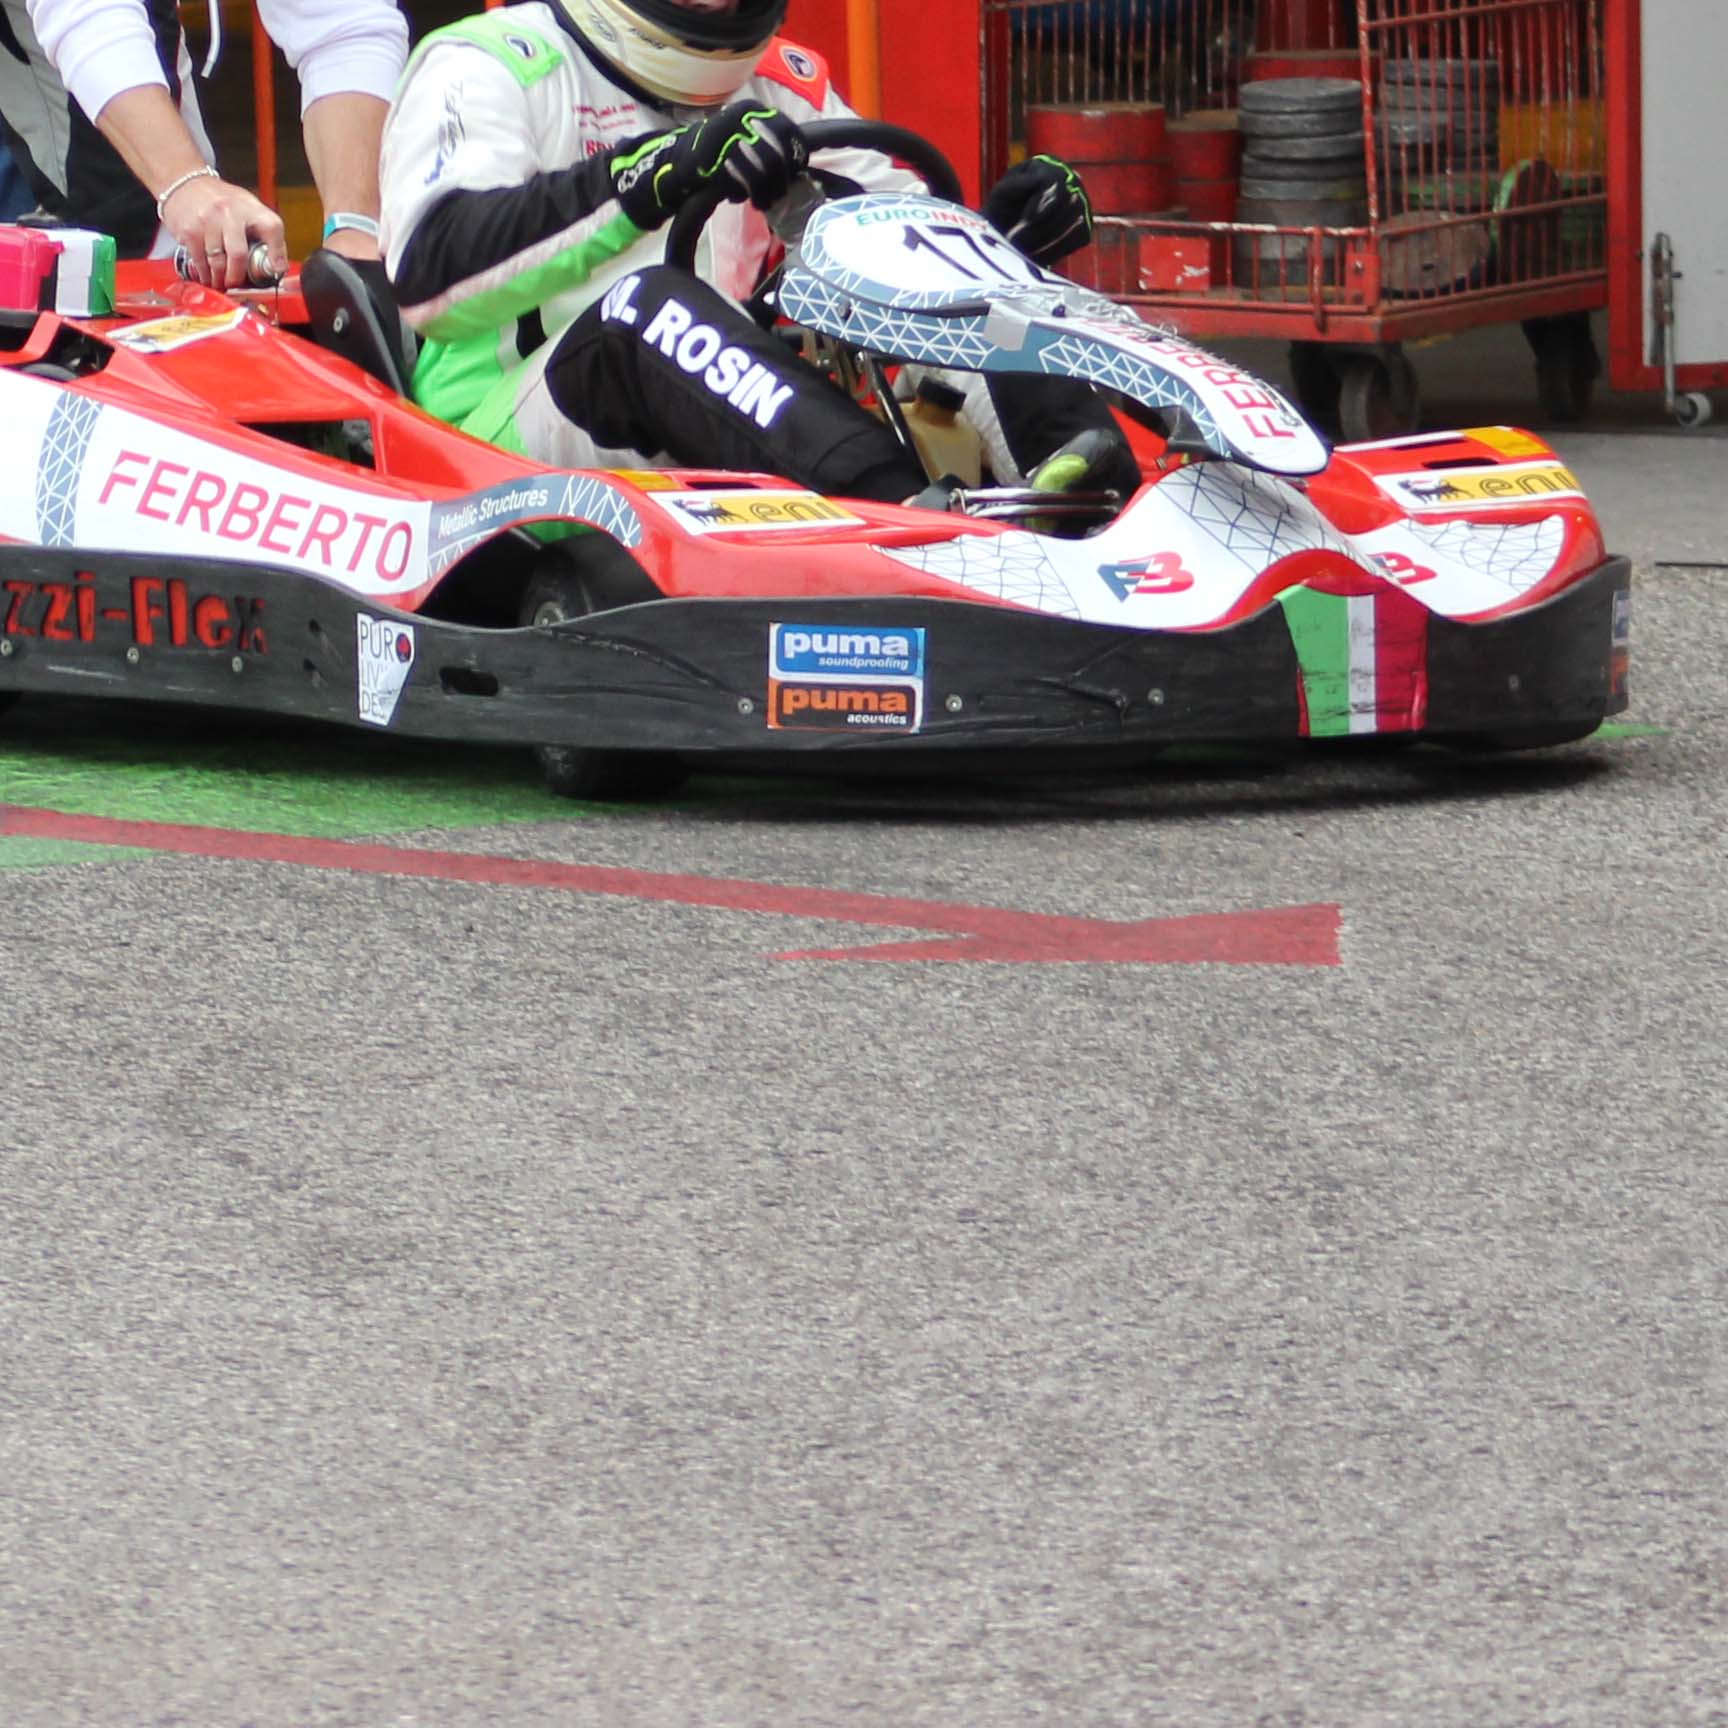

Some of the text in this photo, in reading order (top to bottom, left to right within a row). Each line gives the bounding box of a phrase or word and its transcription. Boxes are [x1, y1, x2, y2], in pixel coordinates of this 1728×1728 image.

[642, 298, 794, 429] ROSIN
[1478, 471, 1578, 498] eni
[98, 450, 414, 583] FERBERTO
[478, 488, 550, 522] Structures
[783, 631, 910, 660] puma
[818, 656, 910, 672] soundproofing
[781, 687, 908, 716] puma
[847, 712, 908, 726] acoustics
